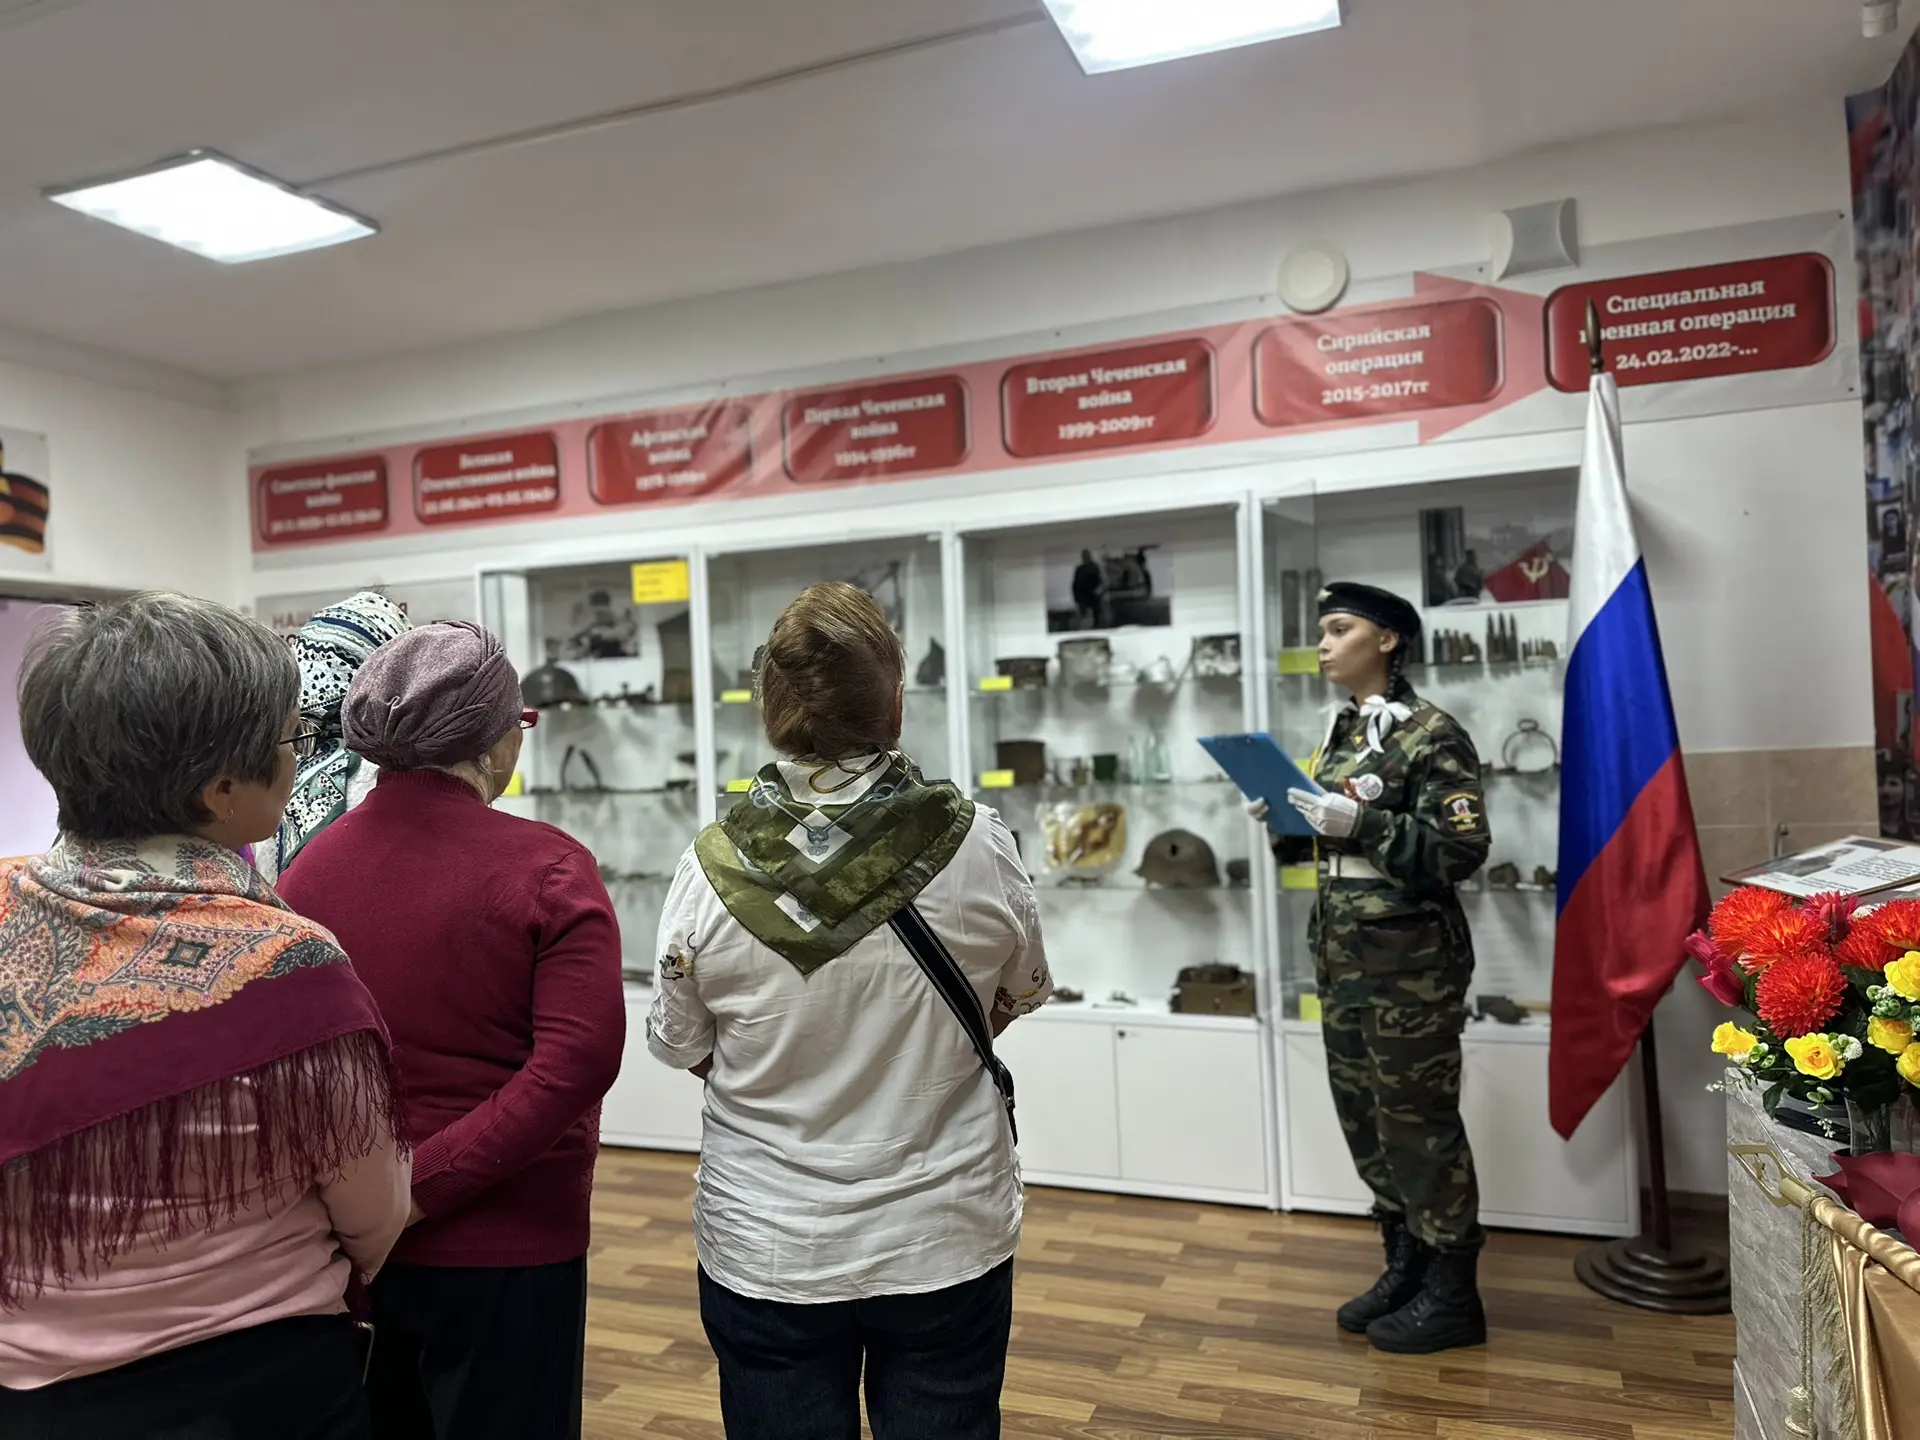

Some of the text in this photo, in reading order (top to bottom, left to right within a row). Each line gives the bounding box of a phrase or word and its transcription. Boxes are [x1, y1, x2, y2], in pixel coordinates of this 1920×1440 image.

[1606, 280, 1765, 314] Специальная
[1679, 303, 1796, 331] операция
[1316, 324, 1431, 353] Сирийская
[1026, 358, 1187, 395] Вторая Чеченская
[1324, 350, 1424, 376] операция
[1077, 389, 1133, 410] война
[1321, 380, 1430, 406] 2015-2017гг
